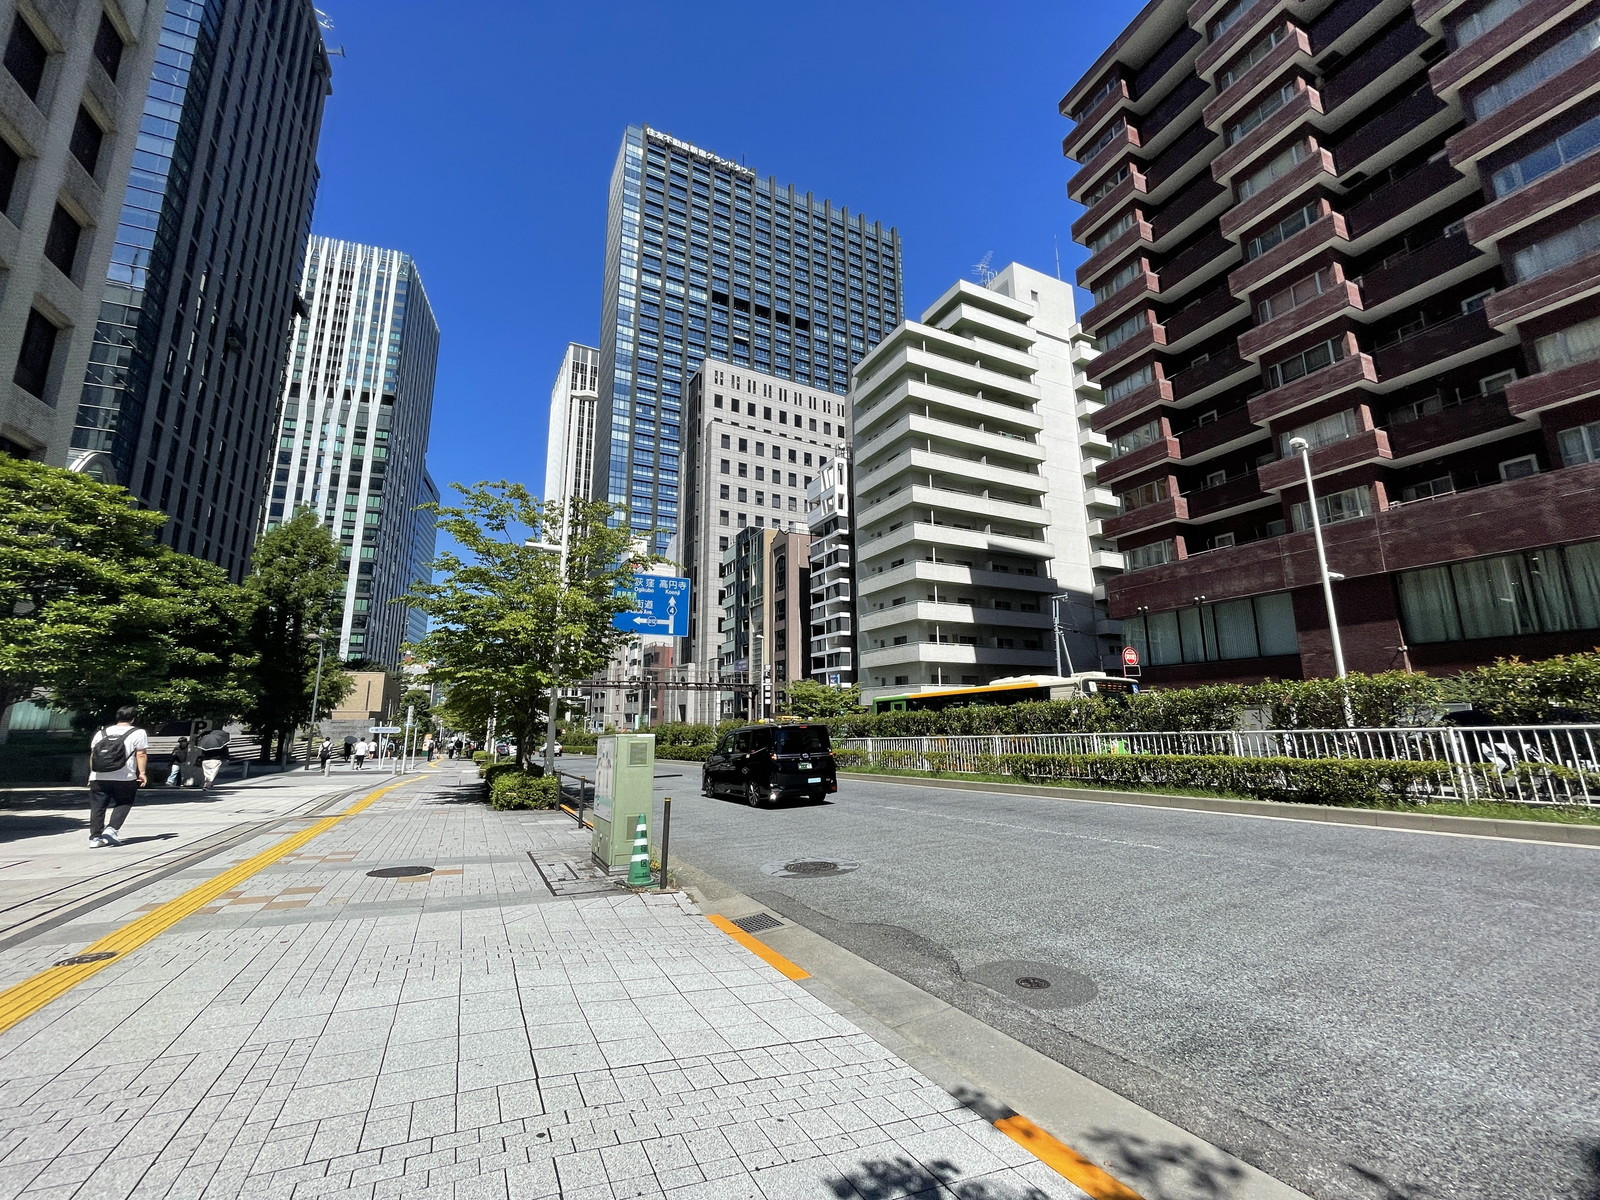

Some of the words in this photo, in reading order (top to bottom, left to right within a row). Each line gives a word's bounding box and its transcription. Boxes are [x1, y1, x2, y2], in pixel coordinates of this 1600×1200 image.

[659, 580, 687, 591] 高円寺
[194, 721, 207, 735] P
